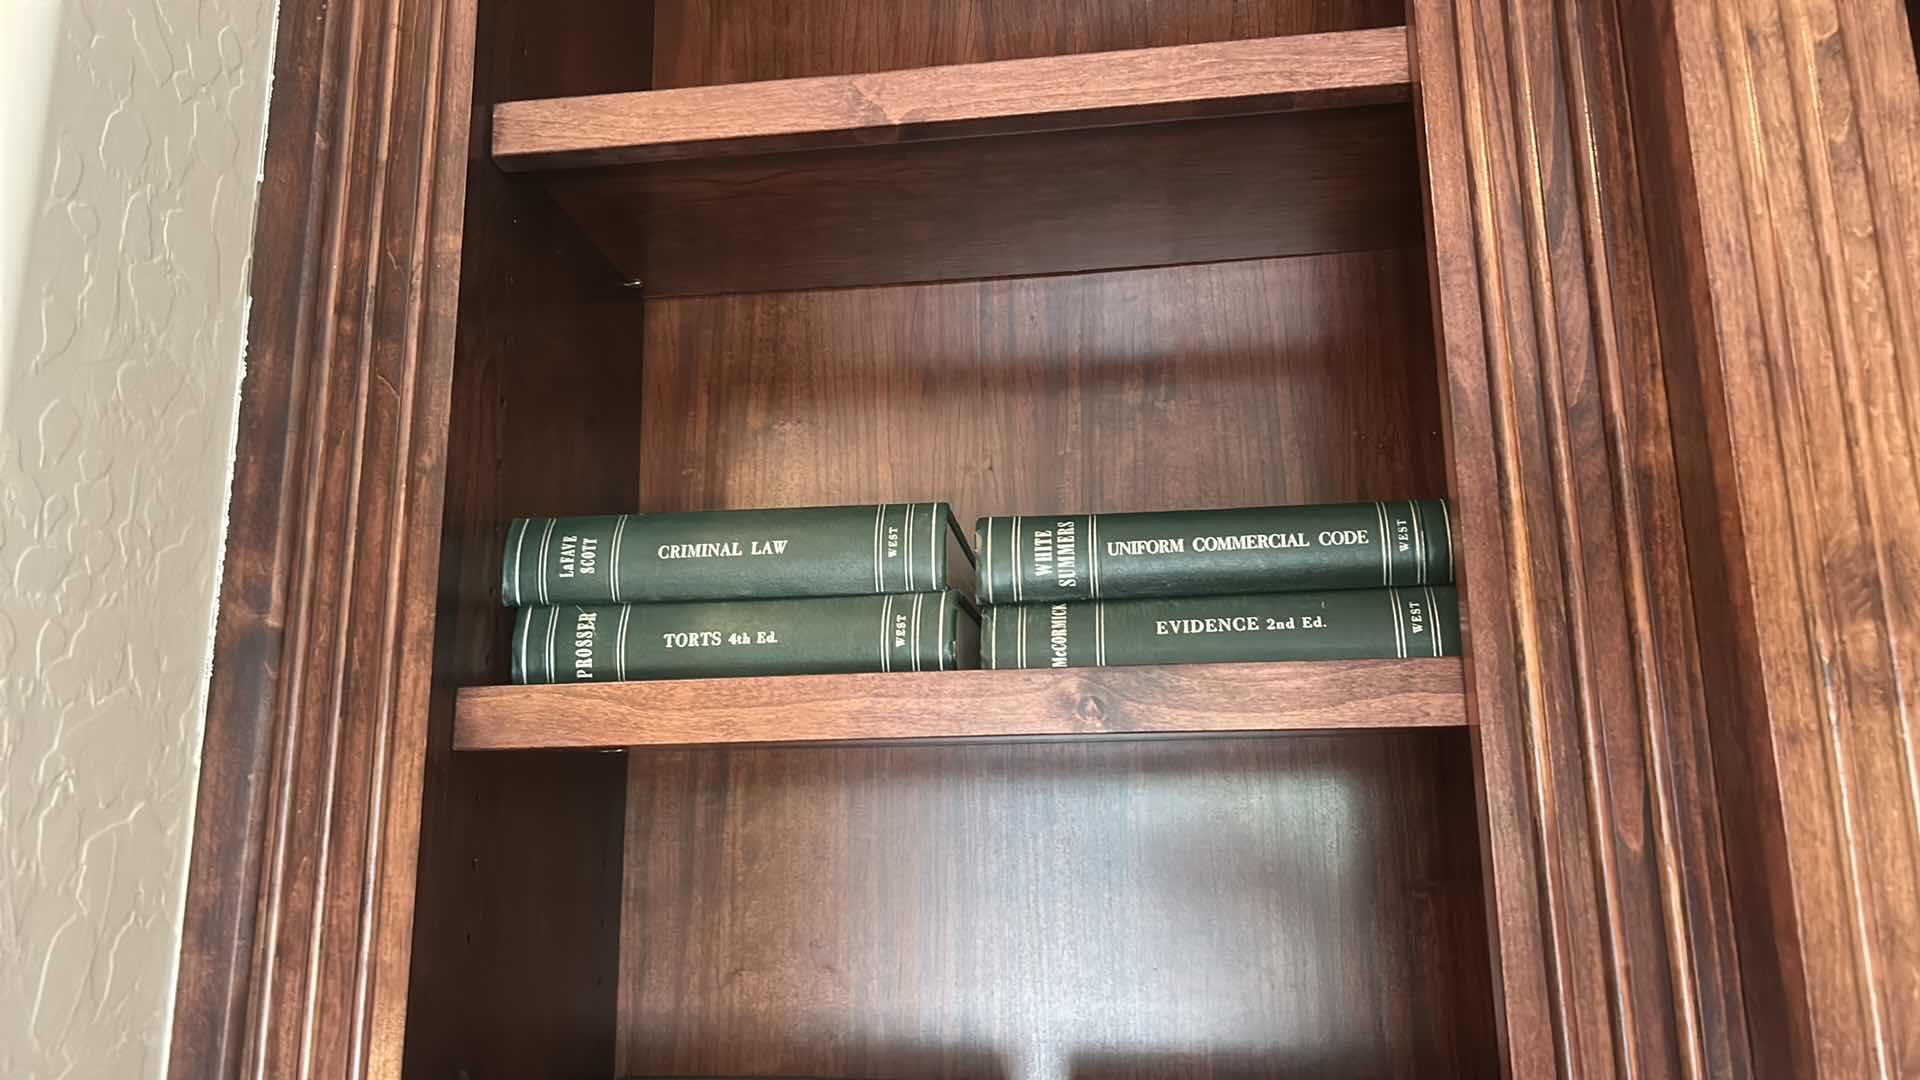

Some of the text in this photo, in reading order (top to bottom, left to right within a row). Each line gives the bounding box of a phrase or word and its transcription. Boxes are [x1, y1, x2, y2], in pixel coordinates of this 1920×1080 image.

[657, 539, 788, 560] CRIMINAL LAW
[887, 526, 899, 558] WEST
[1034, 529, 1053, 577] WHITE
[1106, 528, 1370, 557] UNIFORM COMMERCIAL CODE
[1398, 518, 1409, 553] WEST
[559, 534, 577, 578] LaFAVE
[580, 537, 598, 575] SCOTT
[1057, 520, 1076, 588] SUMMERS
[894, 613, 907, 648] WEST
[1155, 614, 1328, 636] EVIDENCE 2nd Ed.
[1410, 600, 1423, 634] WEST
[575, 611, 598, 679] PROSSER
[663, 630, 779, 648] TORTS 4th Ed.
[1051, 603, 1069, 668] McCORMICK
